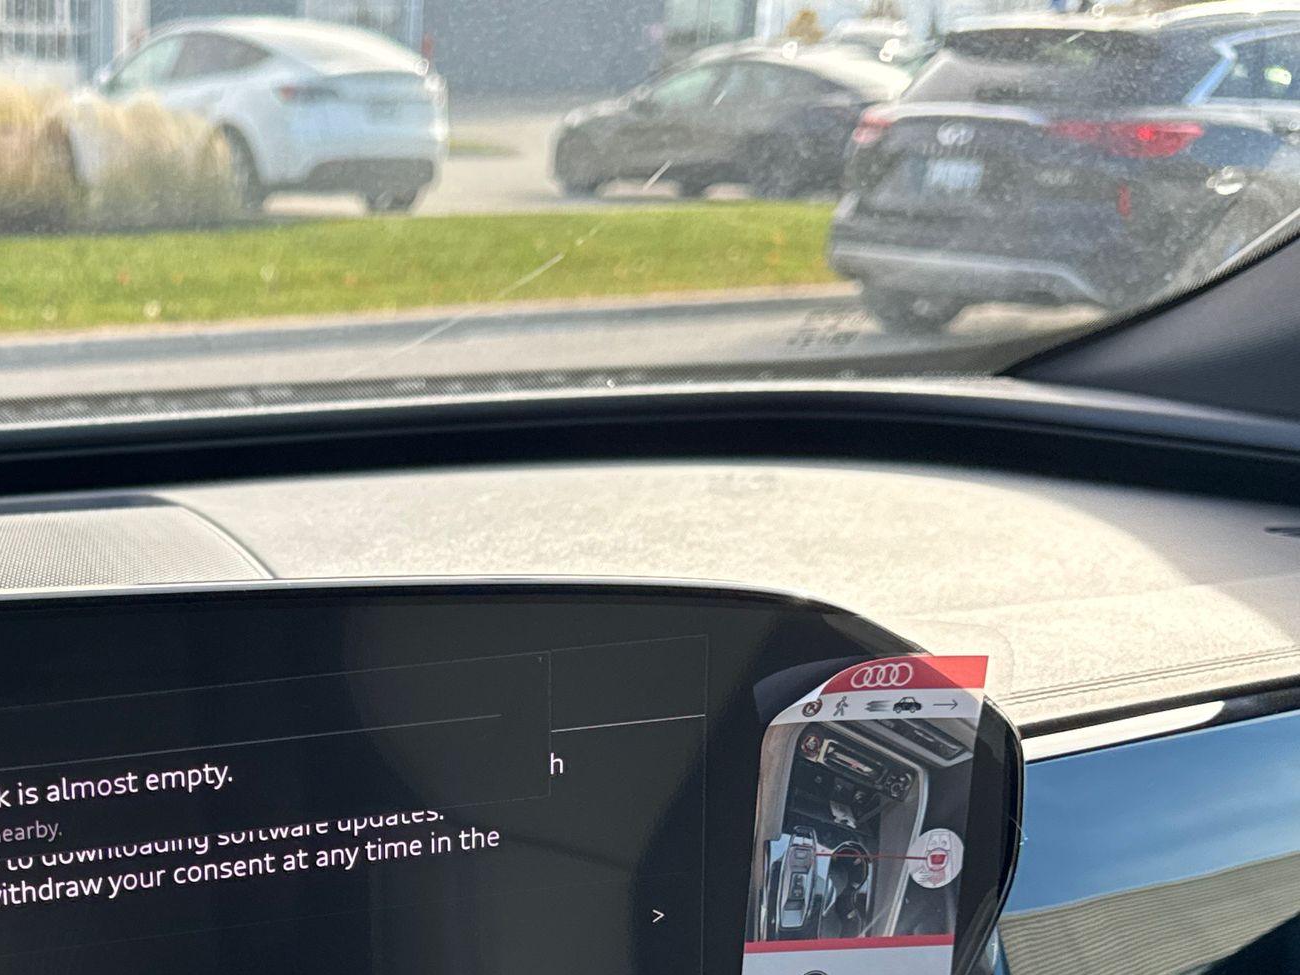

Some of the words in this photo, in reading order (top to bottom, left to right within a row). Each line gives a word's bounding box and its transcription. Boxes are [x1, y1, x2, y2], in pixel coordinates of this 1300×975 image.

[18, 781, 38, 807] is
[47, 773, 137, 802] almost
[146, 763, 233, 793] empty.
[108, 869, 166, 898] your
[174, 852, 275, 885] consent
[282, 850, 308, 871] at
[315, 845, 358, 869] any
[365, 837, 422, 861] time
[430, 831, 451, 853] in
[459, 827, 500, 850] the
